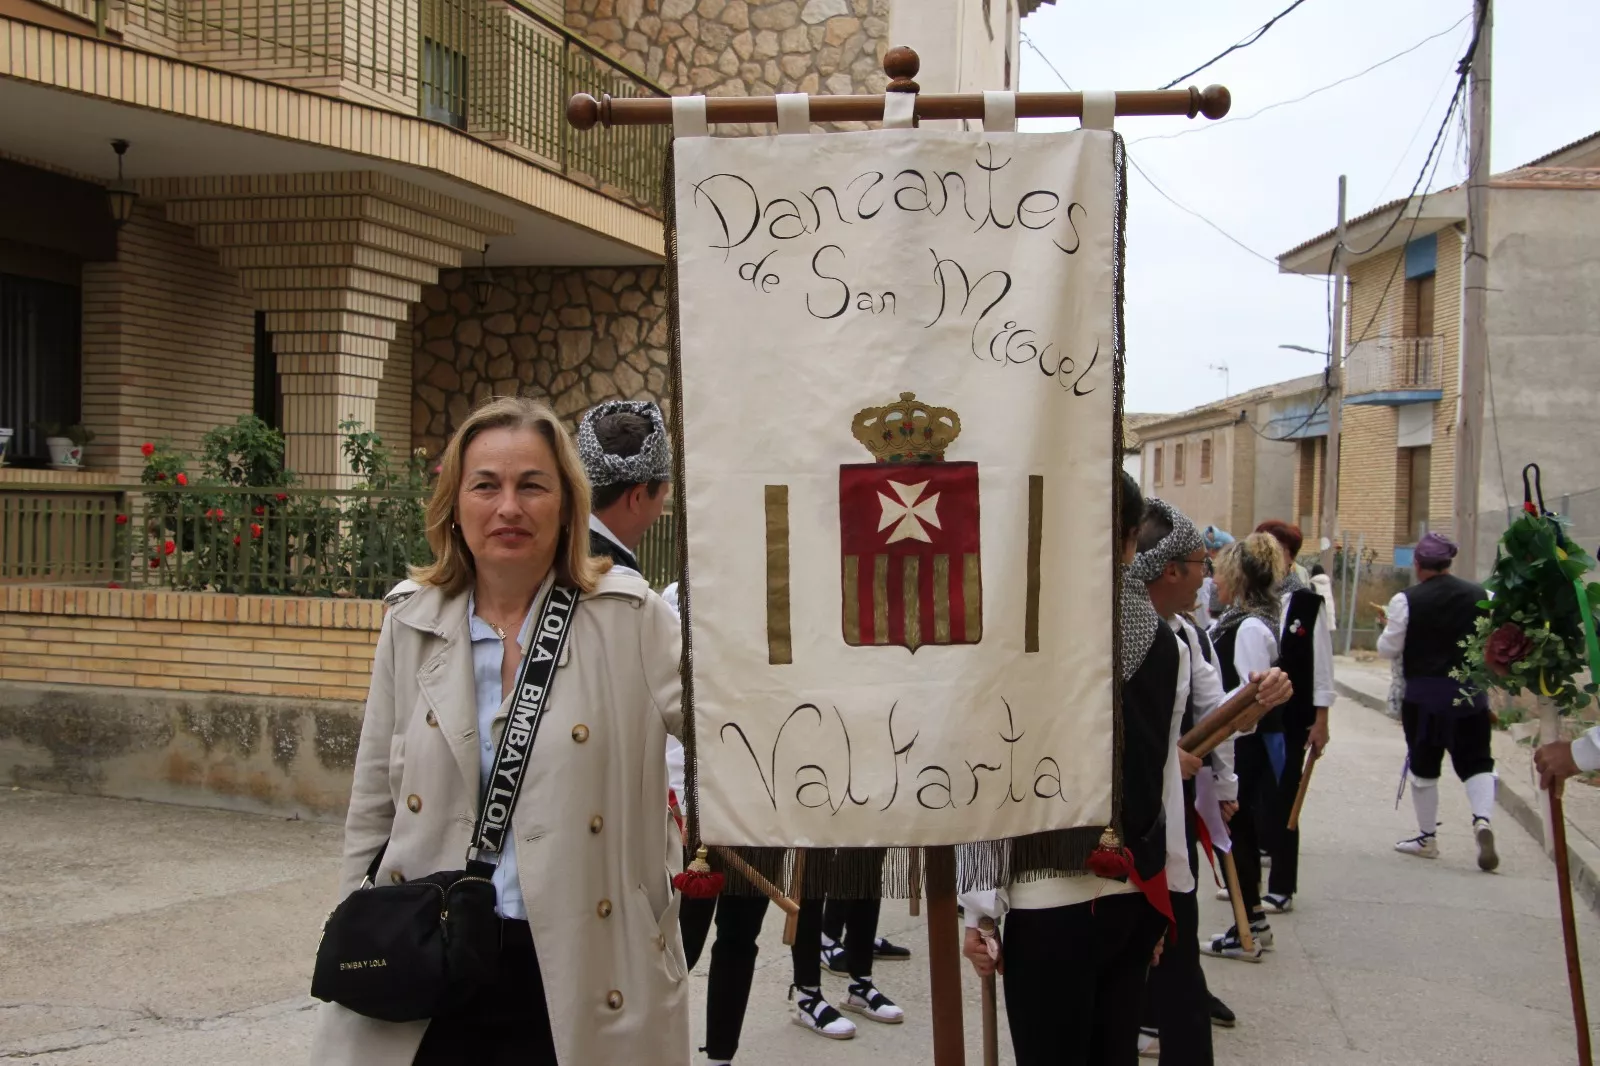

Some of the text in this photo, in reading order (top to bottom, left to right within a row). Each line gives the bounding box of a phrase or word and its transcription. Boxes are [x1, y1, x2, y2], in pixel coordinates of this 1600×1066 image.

[691, 142, 1088, 264] Danzantes
[738, 249, 780, 293] de
[806, 244, 896, 319] San
[531, 601, 569, 662] LOLA
[501, 682, 543, 763] BIMBA
[498, 766, 520, 786] Y
[481, 787, 513, 852] LOLA
[369, 958, 387, 968] LOLA
